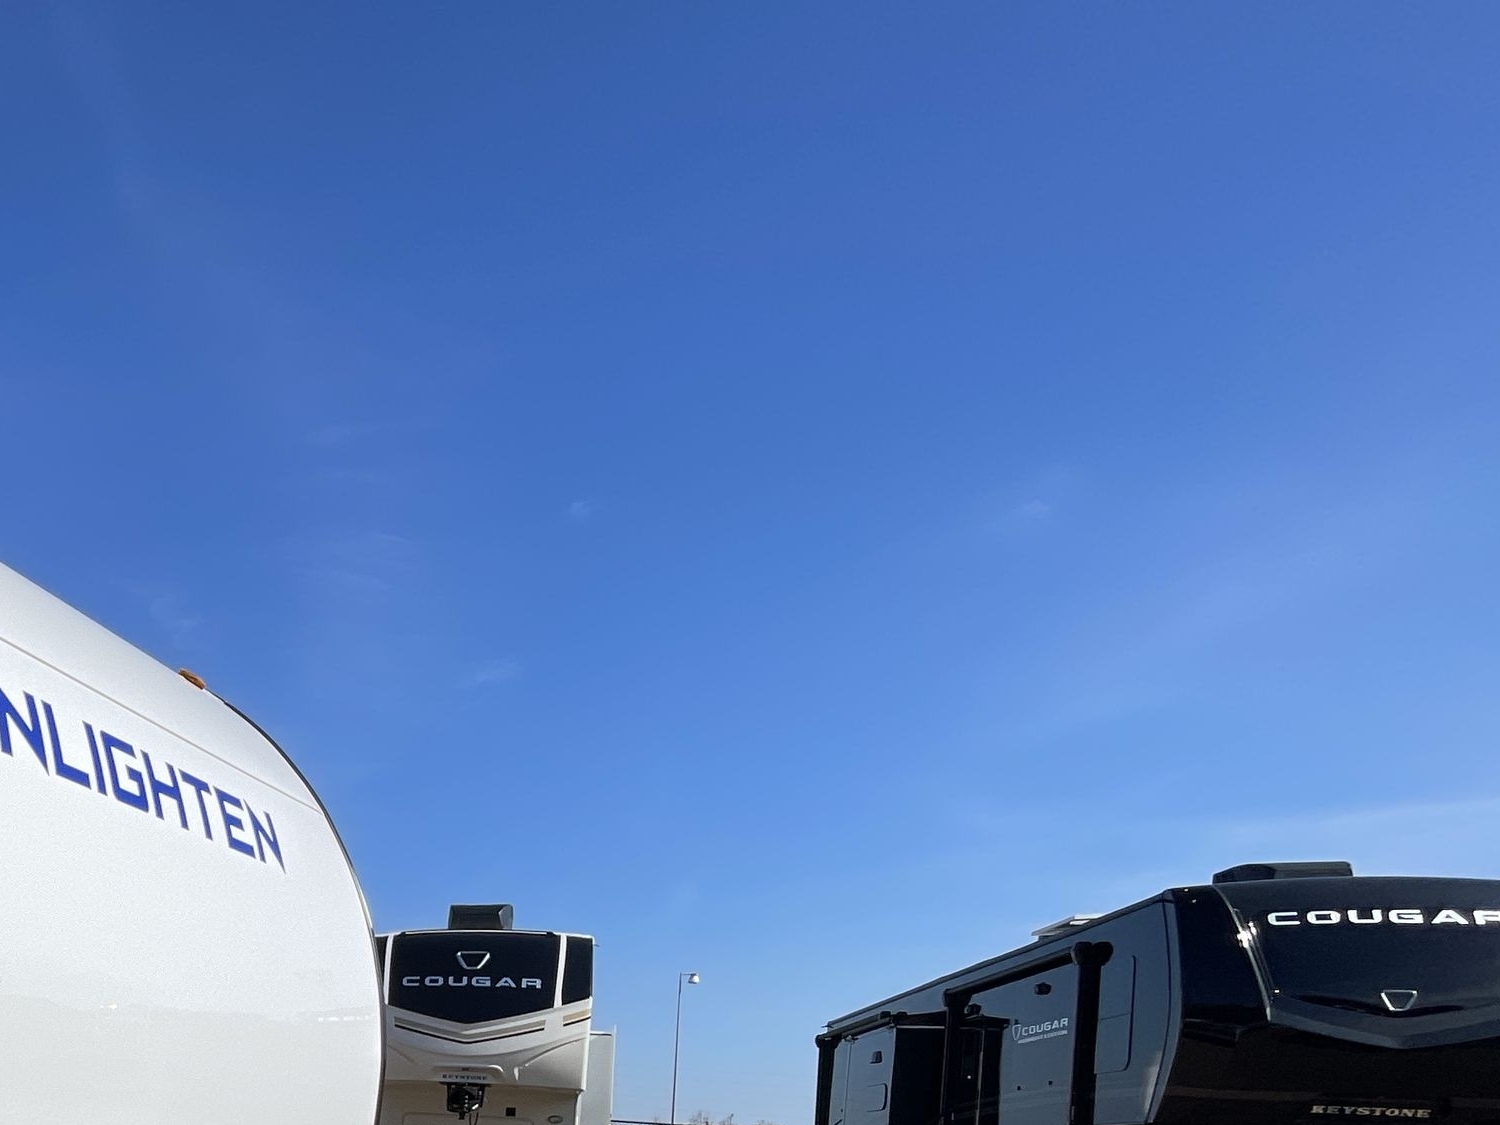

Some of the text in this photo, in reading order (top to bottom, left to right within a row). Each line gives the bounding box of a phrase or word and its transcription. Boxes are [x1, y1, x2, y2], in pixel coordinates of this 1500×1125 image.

[1267, 909, 1500, 925] COUGAR
[402, 975, 542, 989] COUGAR
[1021, 1017, 1069, 1036] COUGAR
[1310, 1105, 1431, 1118] KEYSTONE
